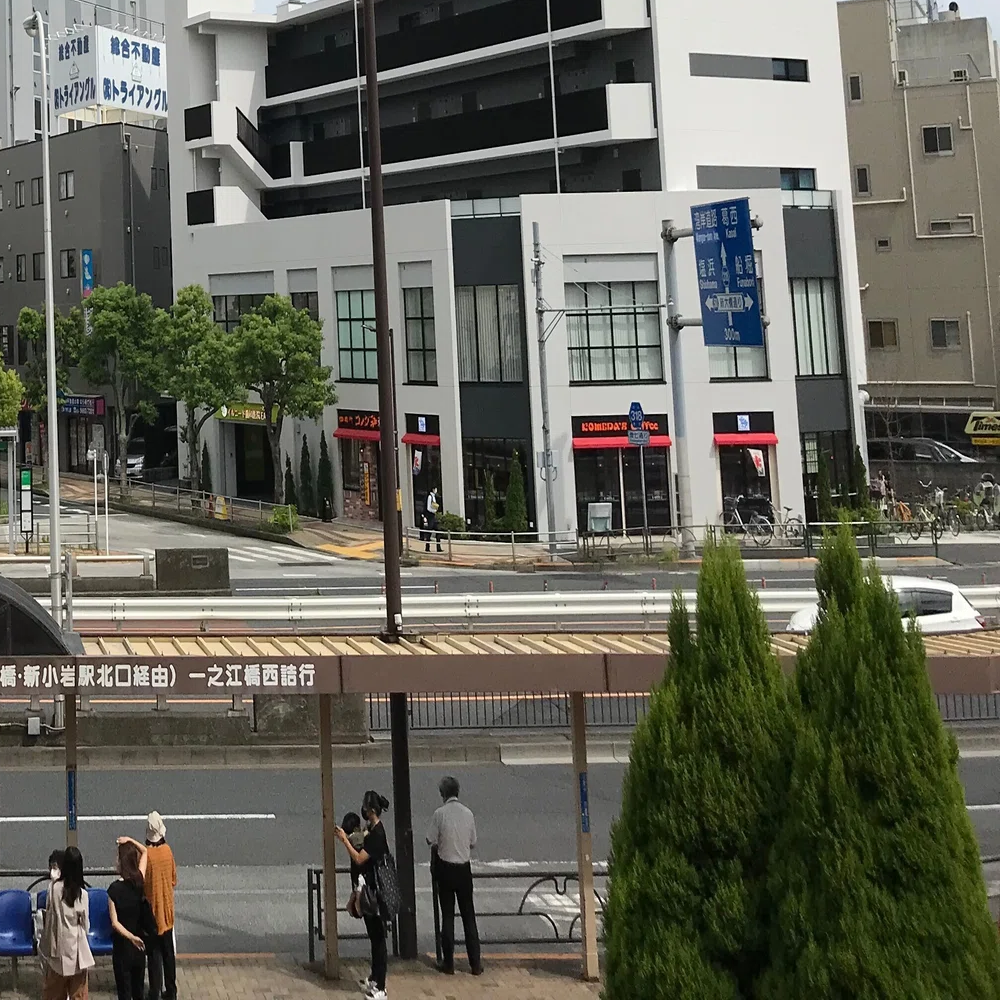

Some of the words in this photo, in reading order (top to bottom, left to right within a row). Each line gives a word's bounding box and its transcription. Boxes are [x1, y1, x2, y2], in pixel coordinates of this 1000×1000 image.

[724, 327, 741, 341] 300m
[630, 410, 643, 421] 318
[630, 421, 659, 431] Cffee
[189, 663, 316, 687] 一之江橋西詰行
